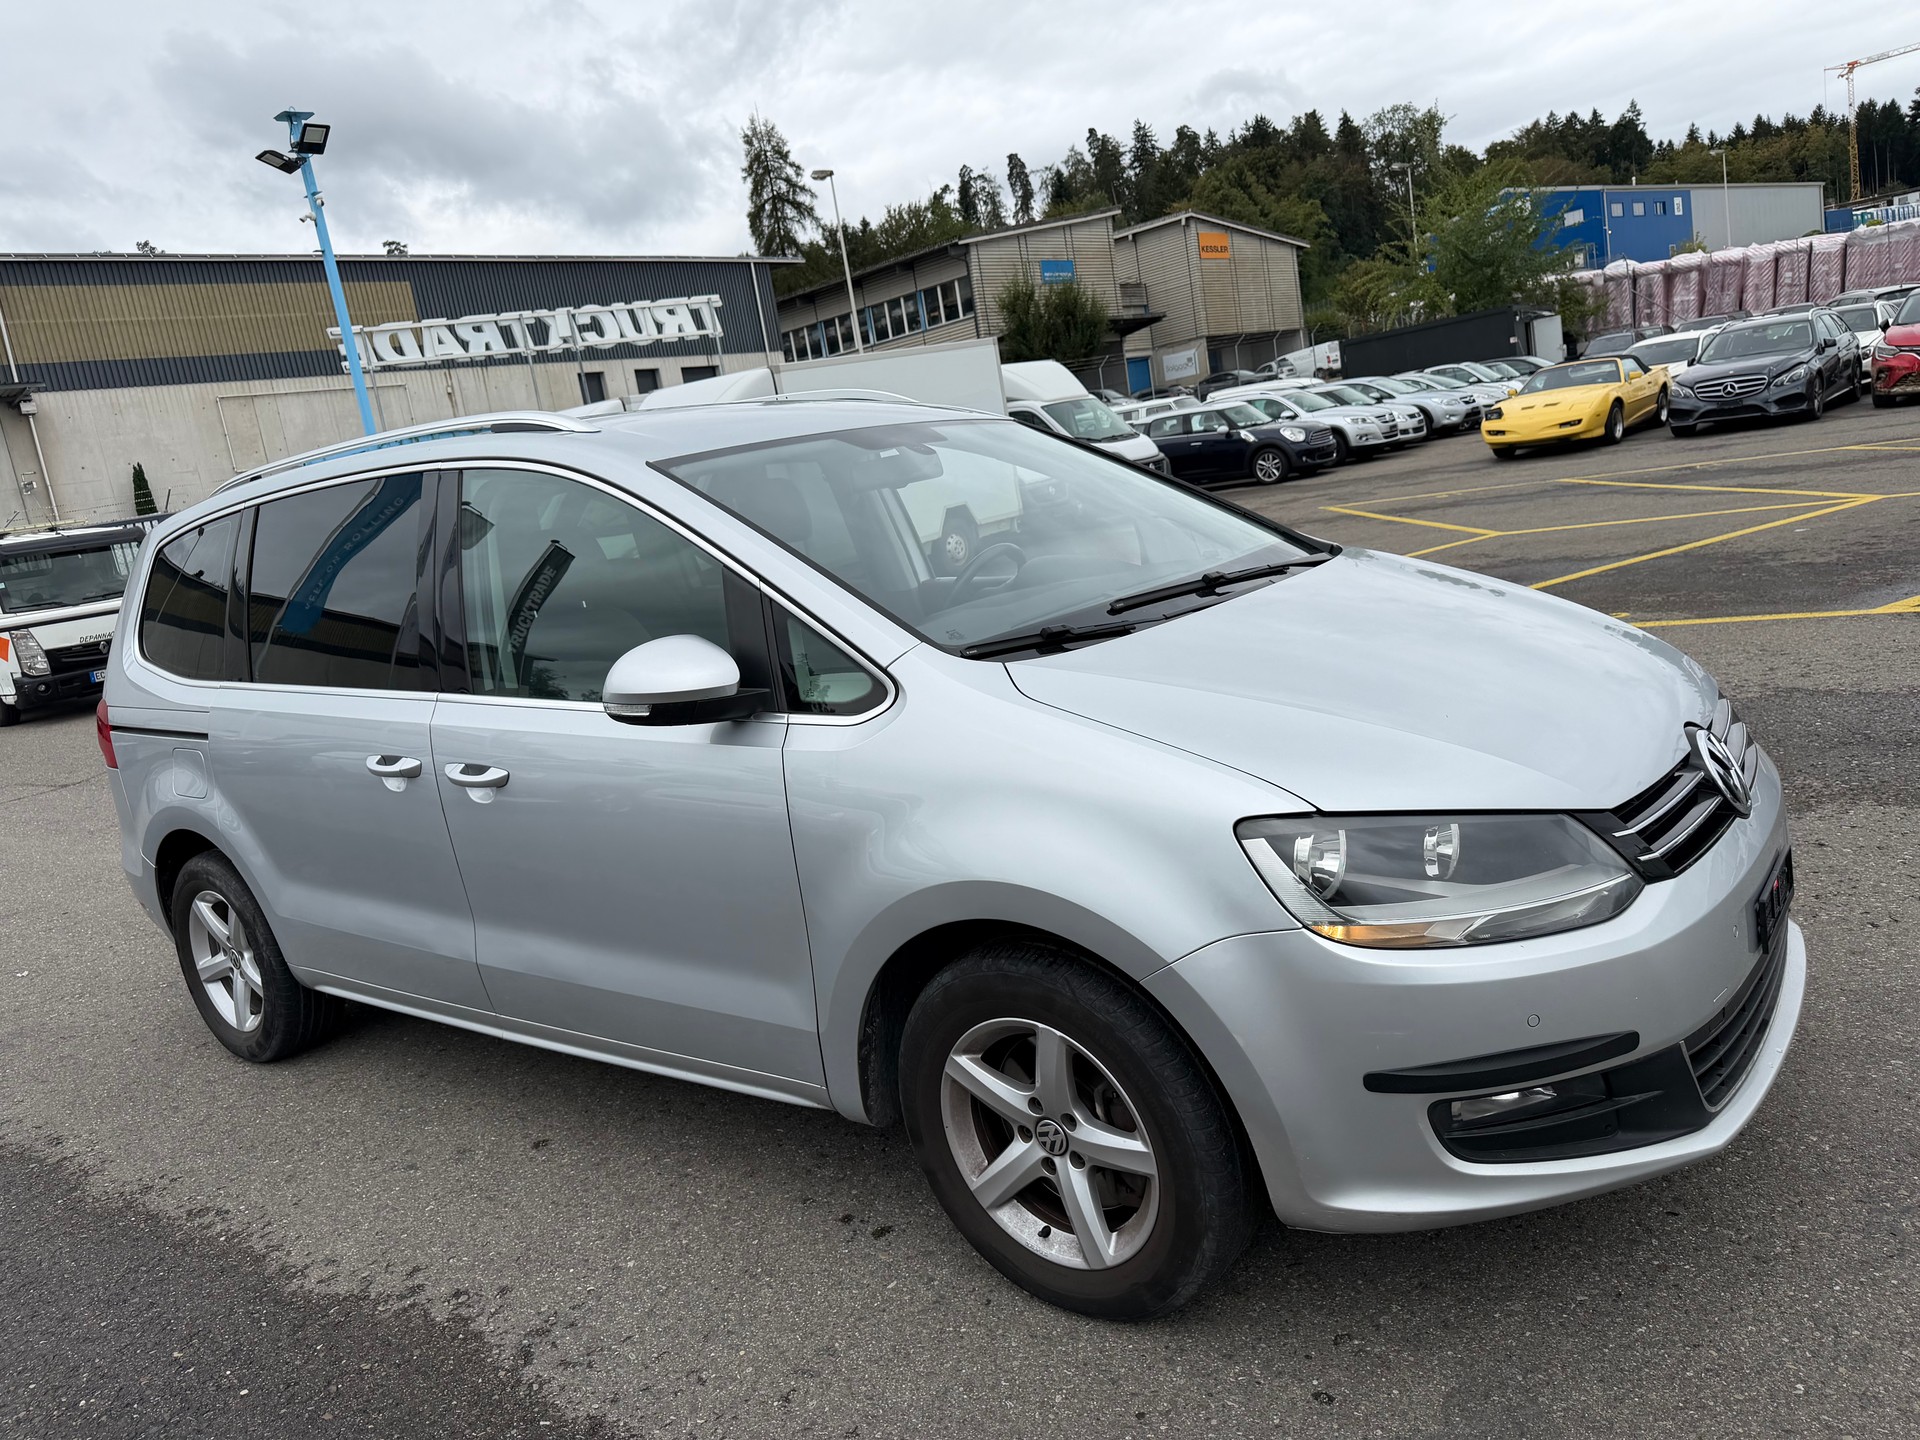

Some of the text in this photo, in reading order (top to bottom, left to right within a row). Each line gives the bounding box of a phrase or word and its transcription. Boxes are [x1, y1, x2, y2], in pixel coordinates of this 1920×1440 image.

[1201, 245, 1229, 253] KESSLER
[326, 555, 341, 573] ON
[344, 497, 404, 550] ROLLING
[506, 565, 557, 653] TRUCKTRADE
